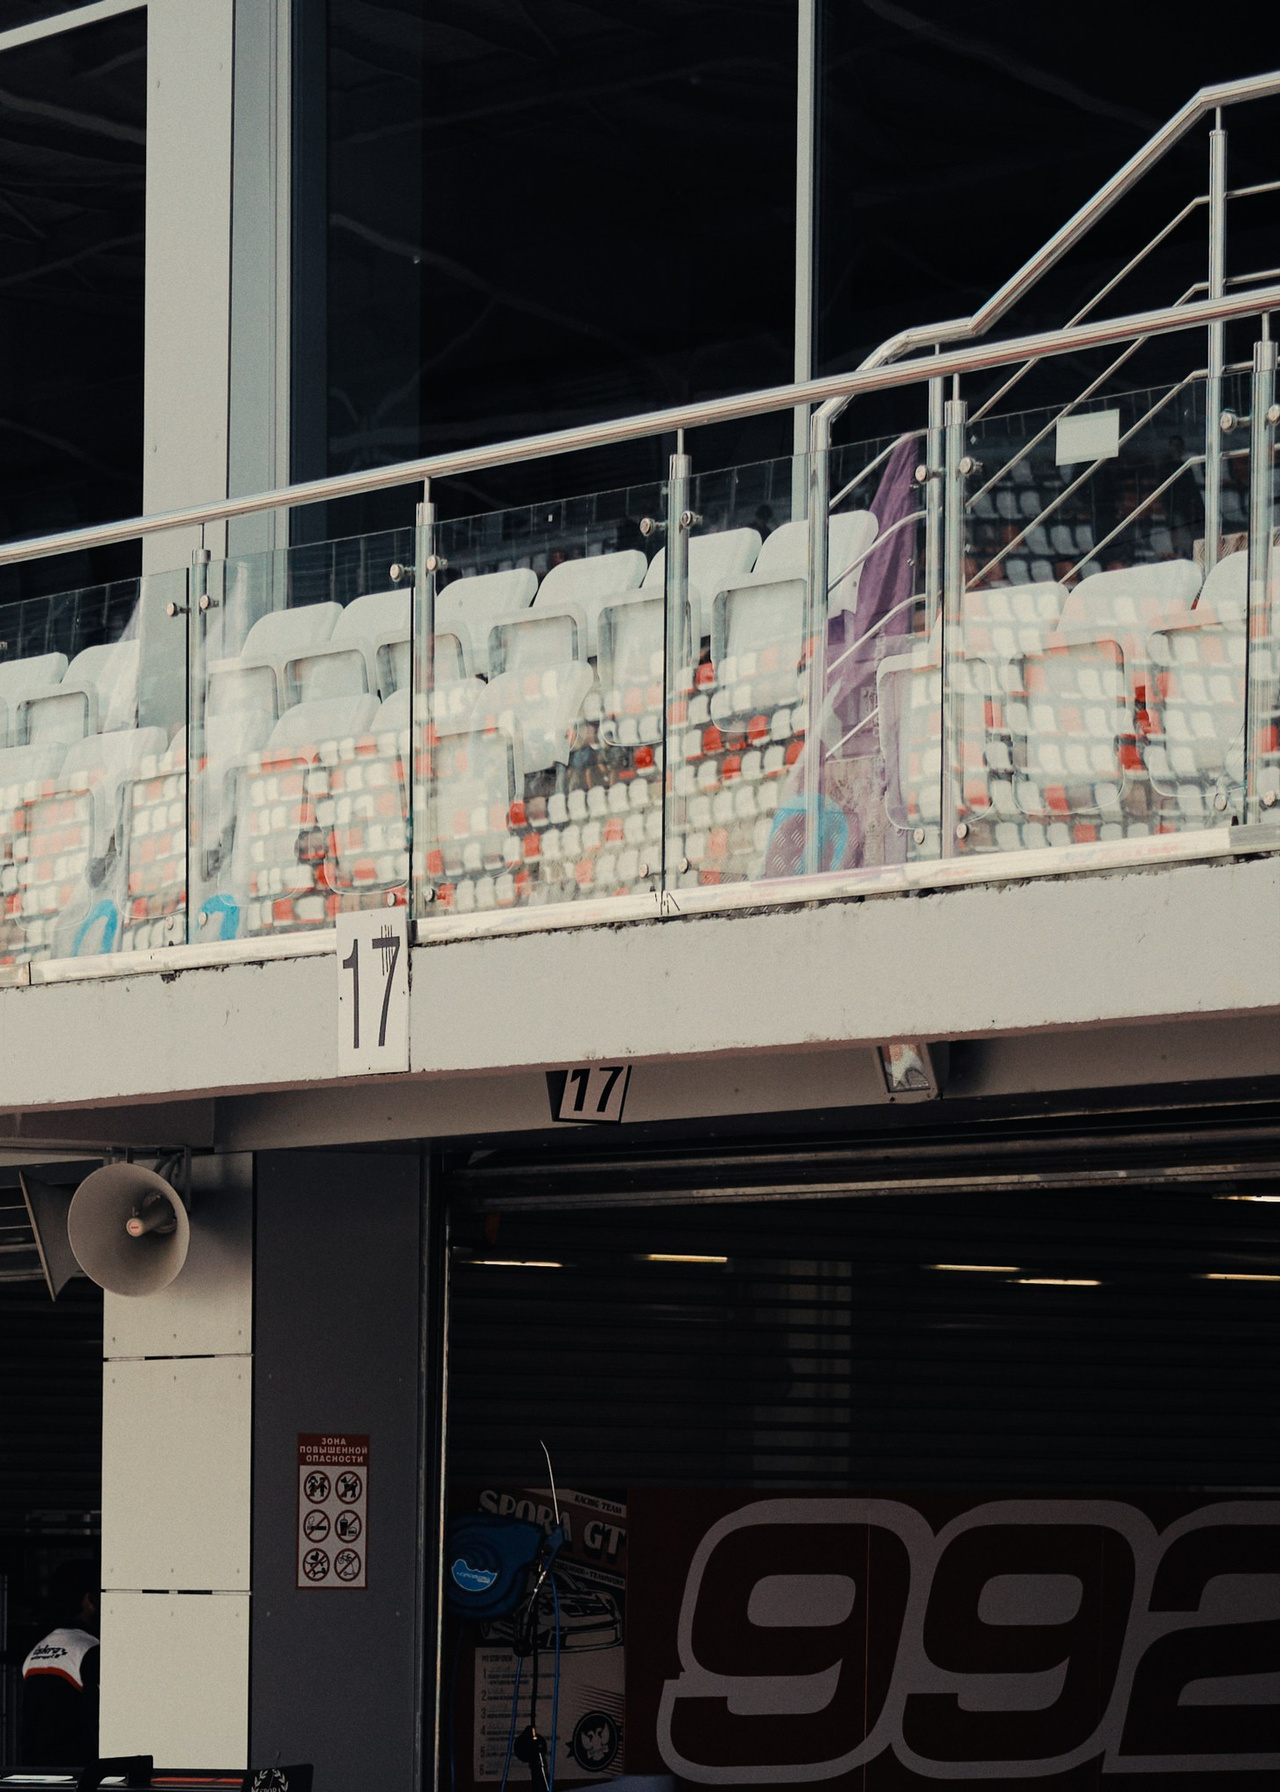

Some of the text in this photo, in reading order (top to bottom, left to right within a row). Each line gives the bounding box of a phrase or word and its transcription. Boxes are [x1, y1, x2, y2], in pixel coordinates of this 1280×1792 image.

[342, 936, 401, 1050] 17
[569, 1065, 624, 1113] 17
[299, 1445, 368, 1455] ПОВЫШЕННОЙ
[321, 1437, 346, 1446] ЗОНА
[305, 1454, 364, 1464] ОПАСНОСТИ
[601, 1502, 622, 1514] TEAM
[583, 1520, 626, 1556] GT
[655, 1497, 1280, 1785] 992
